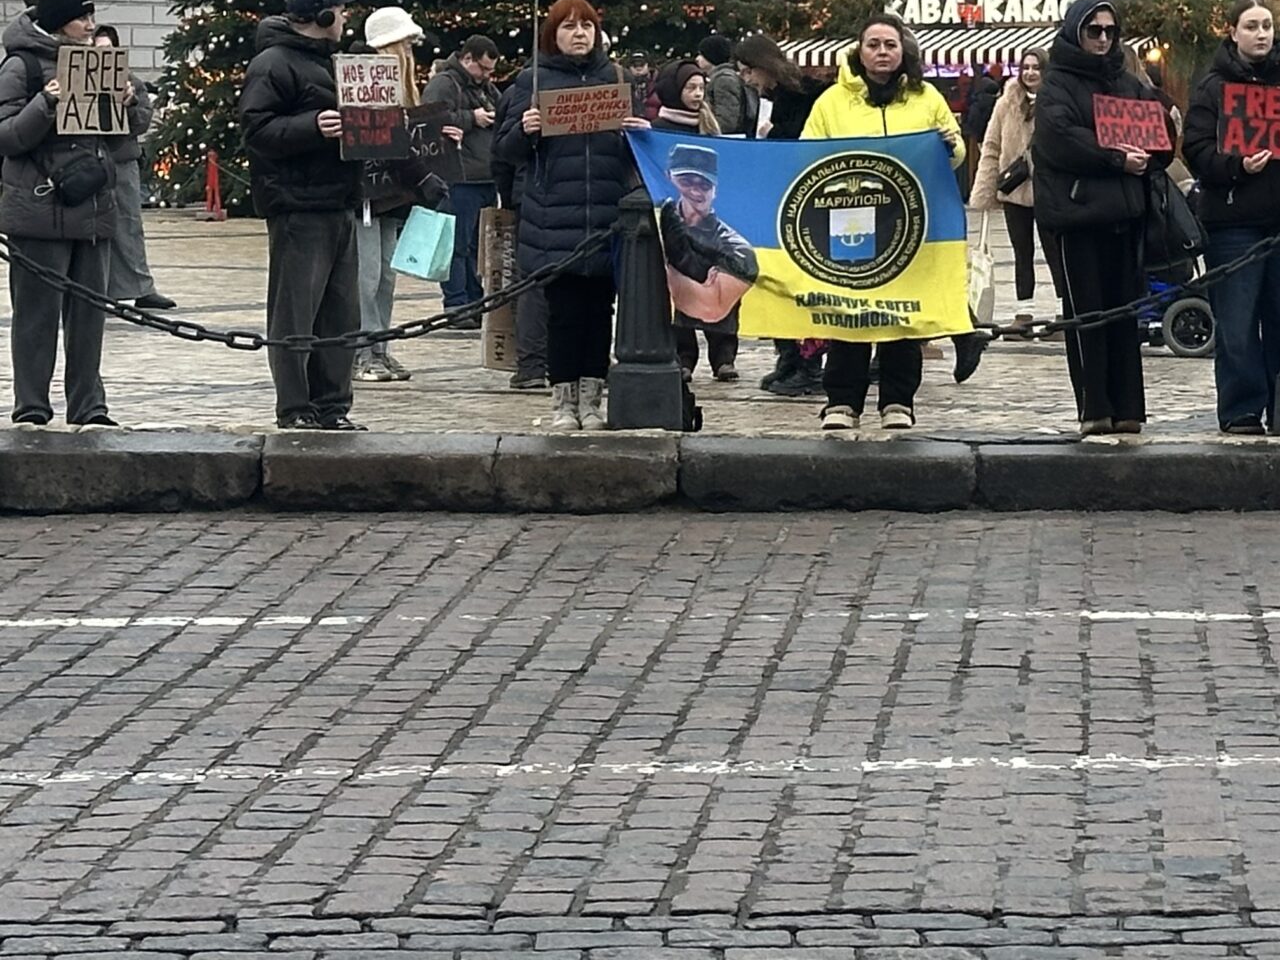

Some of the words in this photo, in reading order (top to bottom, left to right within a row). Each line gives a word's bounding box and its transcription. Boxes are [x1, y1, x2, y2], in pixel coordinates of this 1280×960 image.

[68, 50, 125, 92] FREE
[370, 64, 399, 82] СЕРЦЕ
[341, 86, 354, 103] НЕ
[63, 93, 125, 132] AZOV
[1096, 97, 1162, 123] ПОЛОН
[814, 193, 892, 209] МАРІУПОЛЬ
